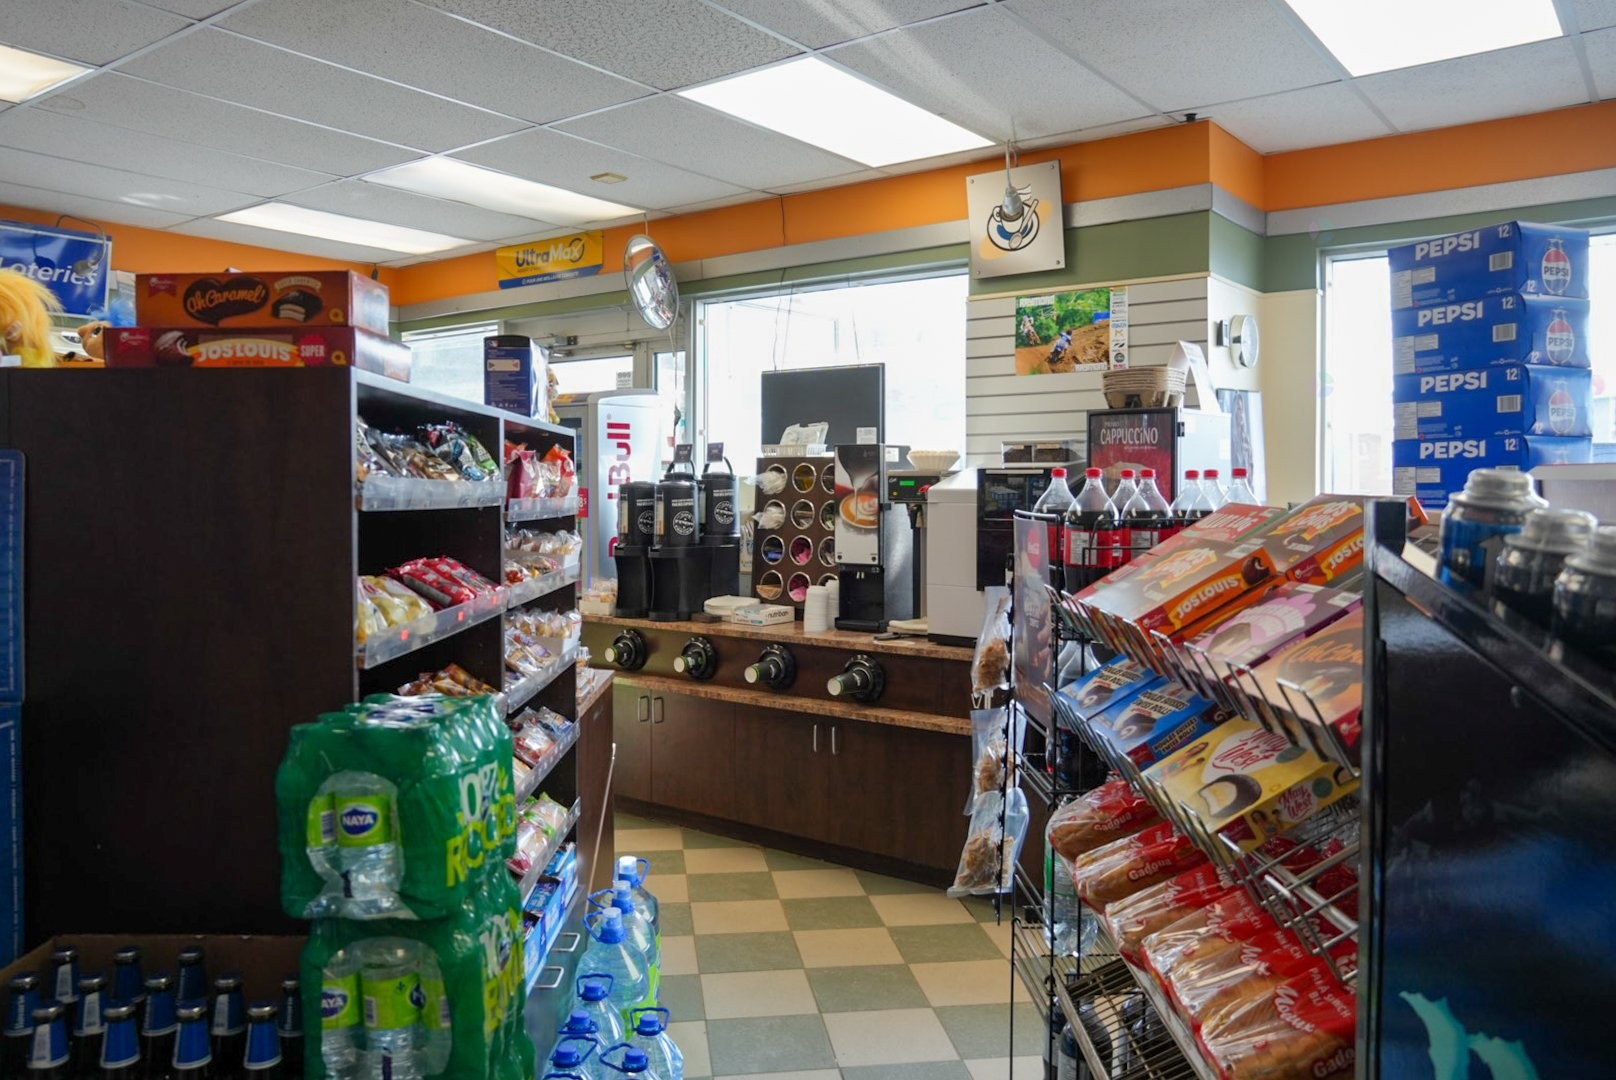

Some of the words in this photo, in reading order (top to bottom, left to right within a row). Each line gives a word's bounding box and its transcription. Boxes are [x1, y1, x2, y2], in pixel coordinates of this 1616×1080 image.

[1499, 225, 1510, 239] 12
[516, 243, 581, 267] UltraMax
[1415, 231, 1480, 261] PEPSI
[1544, 266, 1569, 278] PEPSI
[1502, 297, 1514, 310] 12
[1418, 301, 1483, 327] PEPSI
[300, 345, 325, 357] SUPER
[1548, 336, 1574, 348] PEPSI
[199, 344, 234, 361] JOS
[239, 343, 292, 360] LOUIS
[1420, 371, 1487, 393] PEPSI
[1506, 368, 1518, 381] 12
[1420, 440, 1487, 459] PEPSI
[1505, 438, 1517, 451] 12
[1330, 549, 1351, 569] JOS
[1176, 597, 1200, 619] JOS
[1200, 576, 1239, 601] LOUIS
[342, 814, 375, 826] NAYA
[1094, 812, 1133, 832] Gadoua
[1128, 859, 1173, 880] Gadoua
[321, 997, 346, 1009] AYA
[1313, 1048, 1355, 1077] Gado
